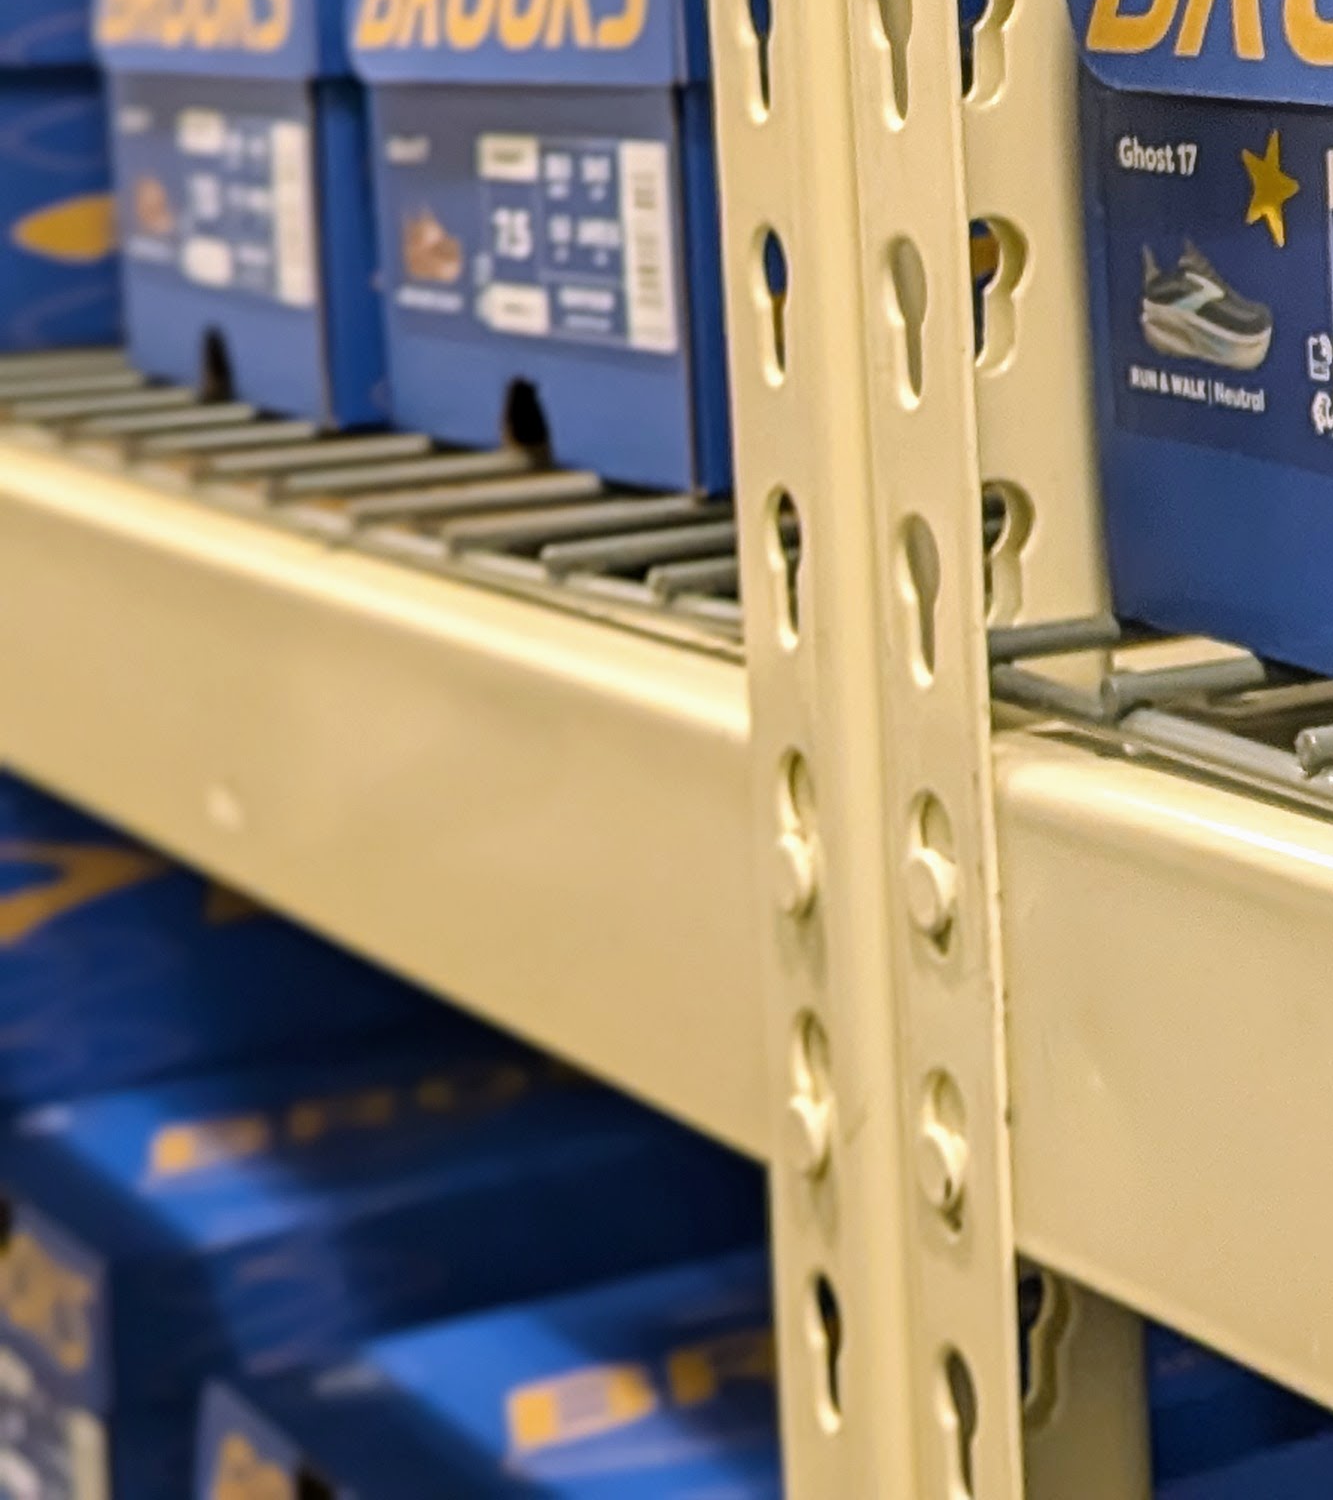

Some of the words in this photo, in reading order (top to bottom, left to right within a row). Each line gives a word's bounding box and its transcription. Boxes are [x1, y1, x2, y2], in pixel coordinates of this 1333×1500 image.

[1119, 135, 1175, 174] Ghost
[1177, 143, 1197, 176] 17
[1171, 372, 1205, 400] WALK
